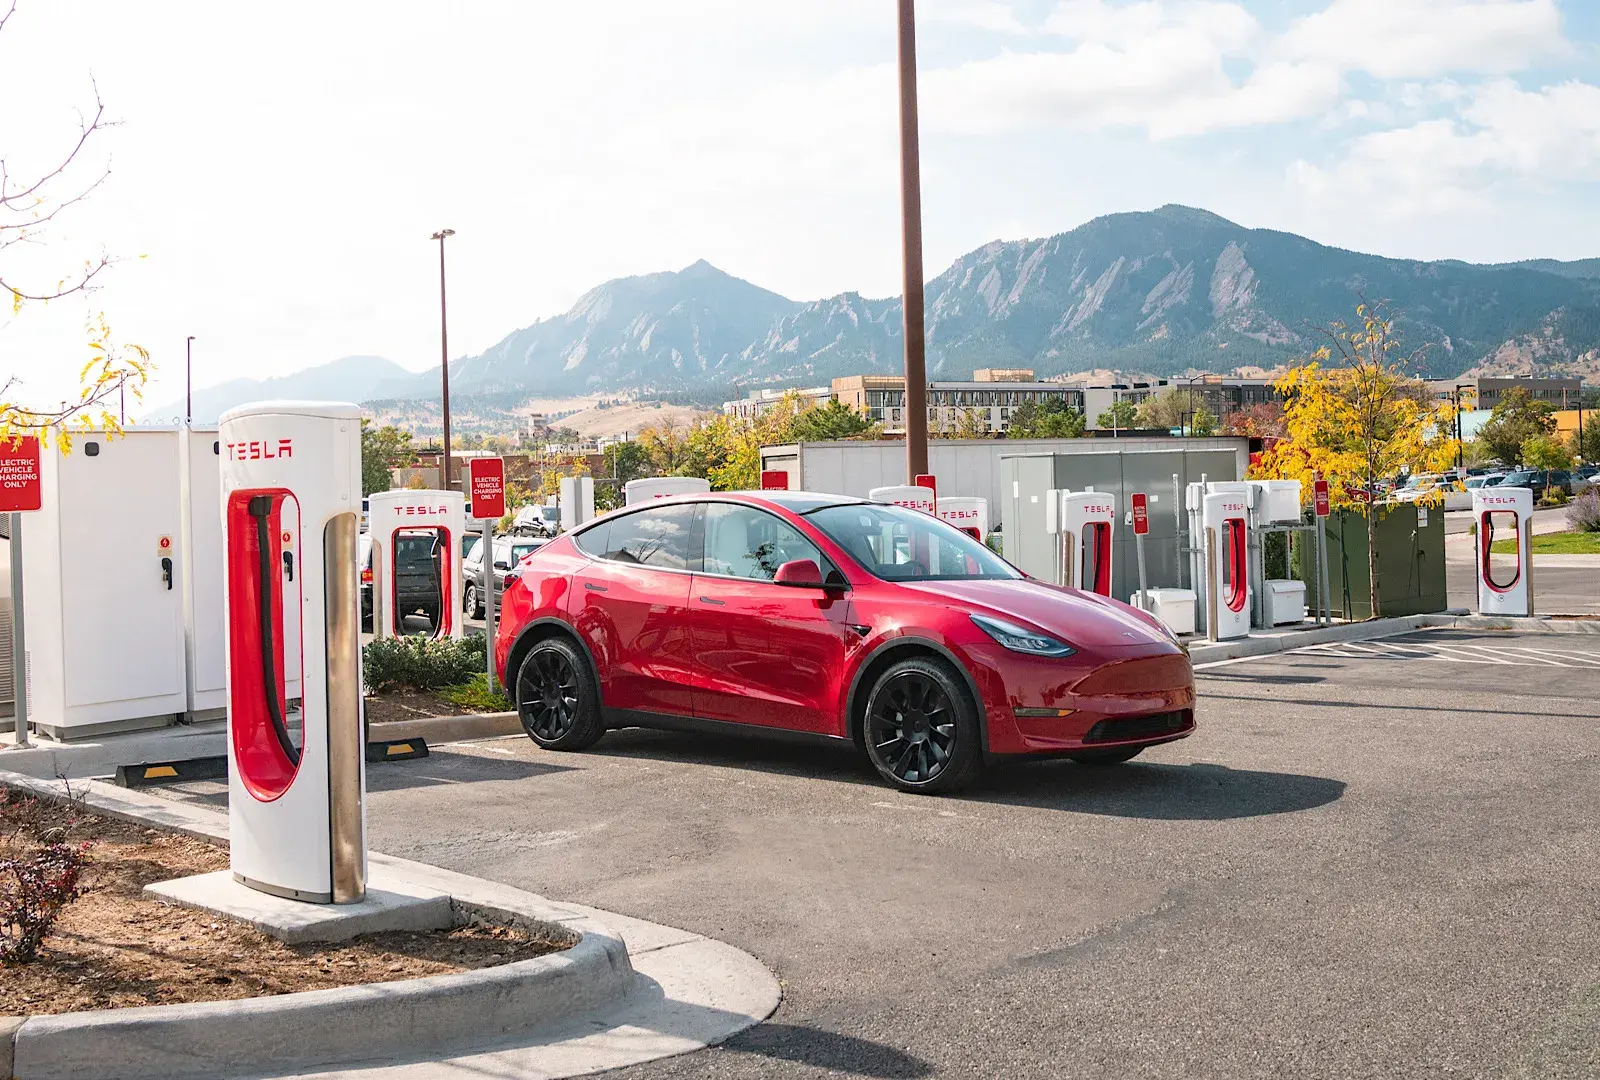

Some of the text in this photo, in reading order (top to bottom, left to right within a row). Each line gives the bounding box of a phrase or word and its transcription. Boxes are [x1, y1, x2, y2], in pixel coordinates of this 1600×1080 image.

[227, 439, 291, 461] TESLA
[0, 466, 33, 474] VEHICLE
[0, 473, 37, 481] HARGING
[394, 506, 447, 515] TESLA
[941, 510, 977, 518] TESLA
